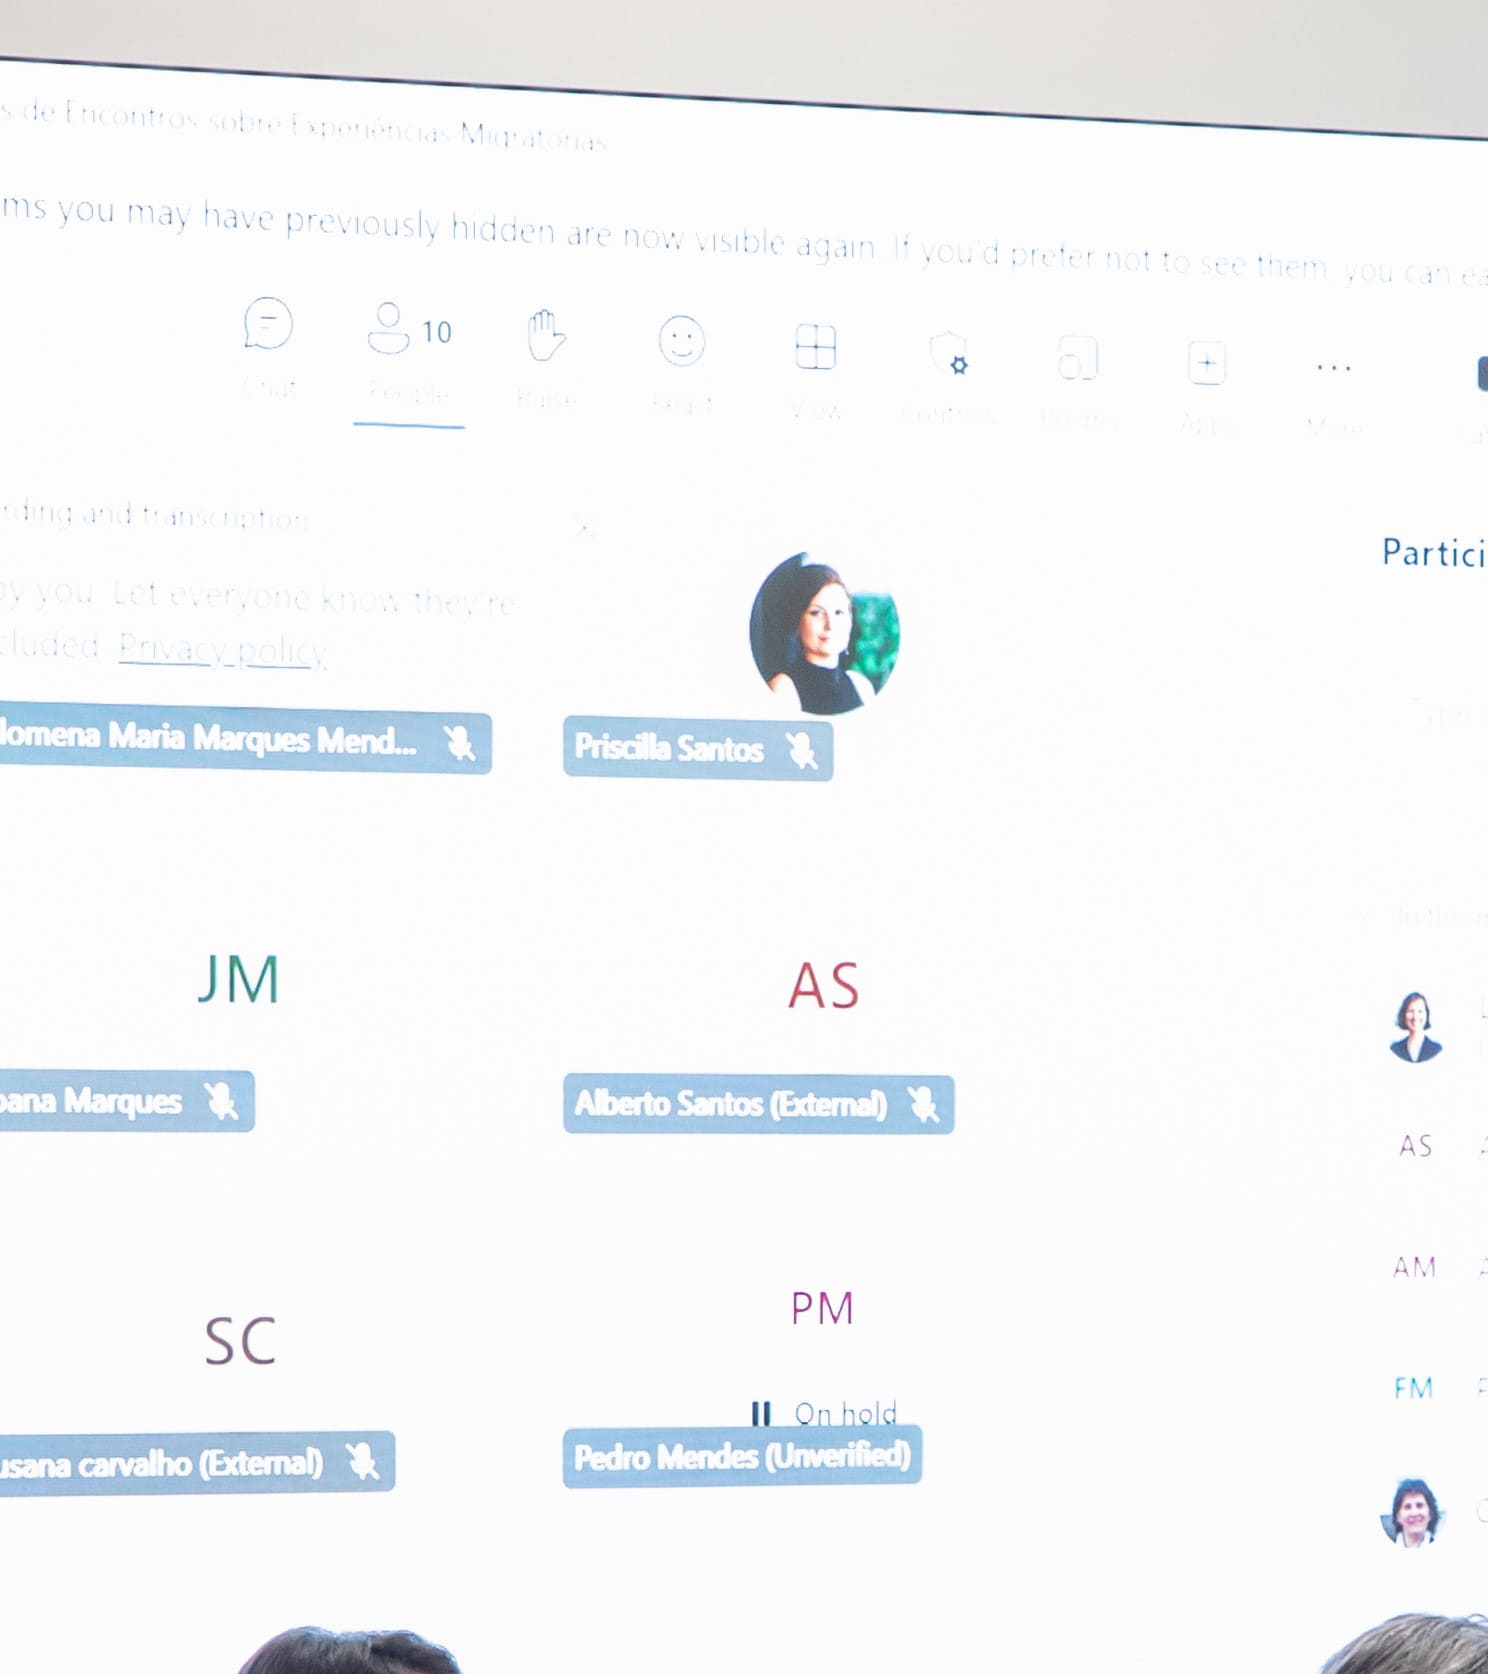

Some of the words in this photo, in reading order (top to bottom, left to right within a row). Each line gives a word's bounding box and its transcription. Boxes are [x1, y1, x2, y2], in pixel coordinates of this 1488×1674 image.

[23, 98, 55, 122] de
[65, 99, 198, 129] Encontros
[59, 201, 114, 229] you
[126, 202, 192, 236] may
[202, 199, 274, 234] have
[287, 207, 440, 247] previously
[451, 210, 555, 245] hidden
[566, 222, 613, 248] are
[623, 226, 684, 252] now
[695, 226, 786, 257] visible
[894, 234, 912, 261] If
[920, 238, 1000, 270] you'd
[1011, 238, 1097, 272] prefer
[1105, 248, 1152, 273] not
[1161, 248, 1191, 275] to
[1200, 253, 1248, 277] see
[1344, 262, 1394, 289] you
[1404, 263, 1452, 286] can
[422, 319, 454, 346] 10
[118, 632, 226, 667] Privacy
[239, 636, 327, 670] policy
[109, 720, 185, 750] Maria
[194, 724, 311, 760] Marques
[318, 726, 417, 757] Mend...
[574, 732, 672, 762] Priscilla
[678, 735, 765, 764] Santos
[198, 953, 278, 1004] JM
[788, 961, 860, 1009] AS
[63, 1087, 183, 1121] Marques
[574, 1089, 672, 1118] Alberto
[677, 1090, 765, 1119] Santos
[769, 1088, 888, 1122] (External)
[1398, 1133, 1434, 1160] AS
[1392, 1255, 1438, 1280] AM
[792, 1291, 853, 1324] PM
[205, 1316, 275, 1366] SC
[1393, 1375, 1434, 1400] FM
[794, 1401, 832, 1426] On
[842, 1400, 897, 1426] hold
[78, 1448, 193, 1478] carvalho
[199, 1446, 323, 1481] (External)
[574, 1443, 651, 1472] Pedro
[657, 1442, 759, 1470] Mendes
[765, 1438, 912, 1473] (Unverified)
